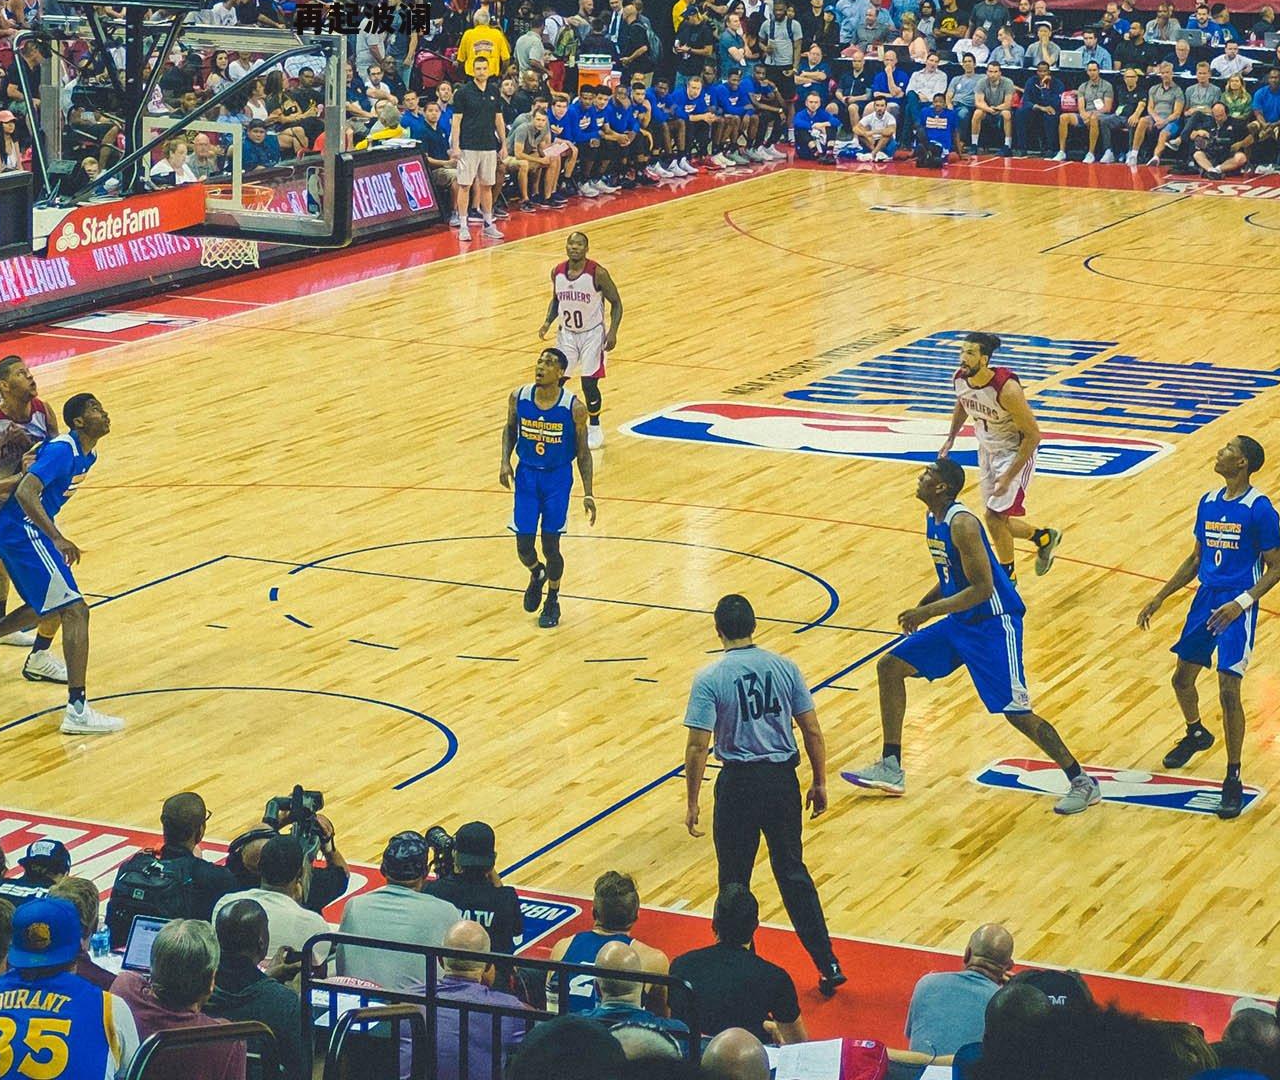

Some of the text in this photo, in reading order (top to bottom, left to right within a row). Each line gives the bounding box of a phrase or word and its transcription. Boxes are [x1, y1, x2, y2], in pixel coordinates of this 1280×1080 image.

[359, 171, 402, 219] LEAGUE
[411, 171, 429, 199] TV
[14, 255, 76, 297] LEAGUE
[92, 242, 129, 271] MGM
[128, 233, 191, 263] RESORTS
[563, 310, 583, 329] 20
[521, 417, 563, 431] WARRIORS
[535, 442, 545, 456] 6
[1205, 521, 1241, 533] WARRIORS
[1215, 550, 1222, 567] 0
[734, 671, 782, 722] 134
[474, 910, 495, 928] TV
